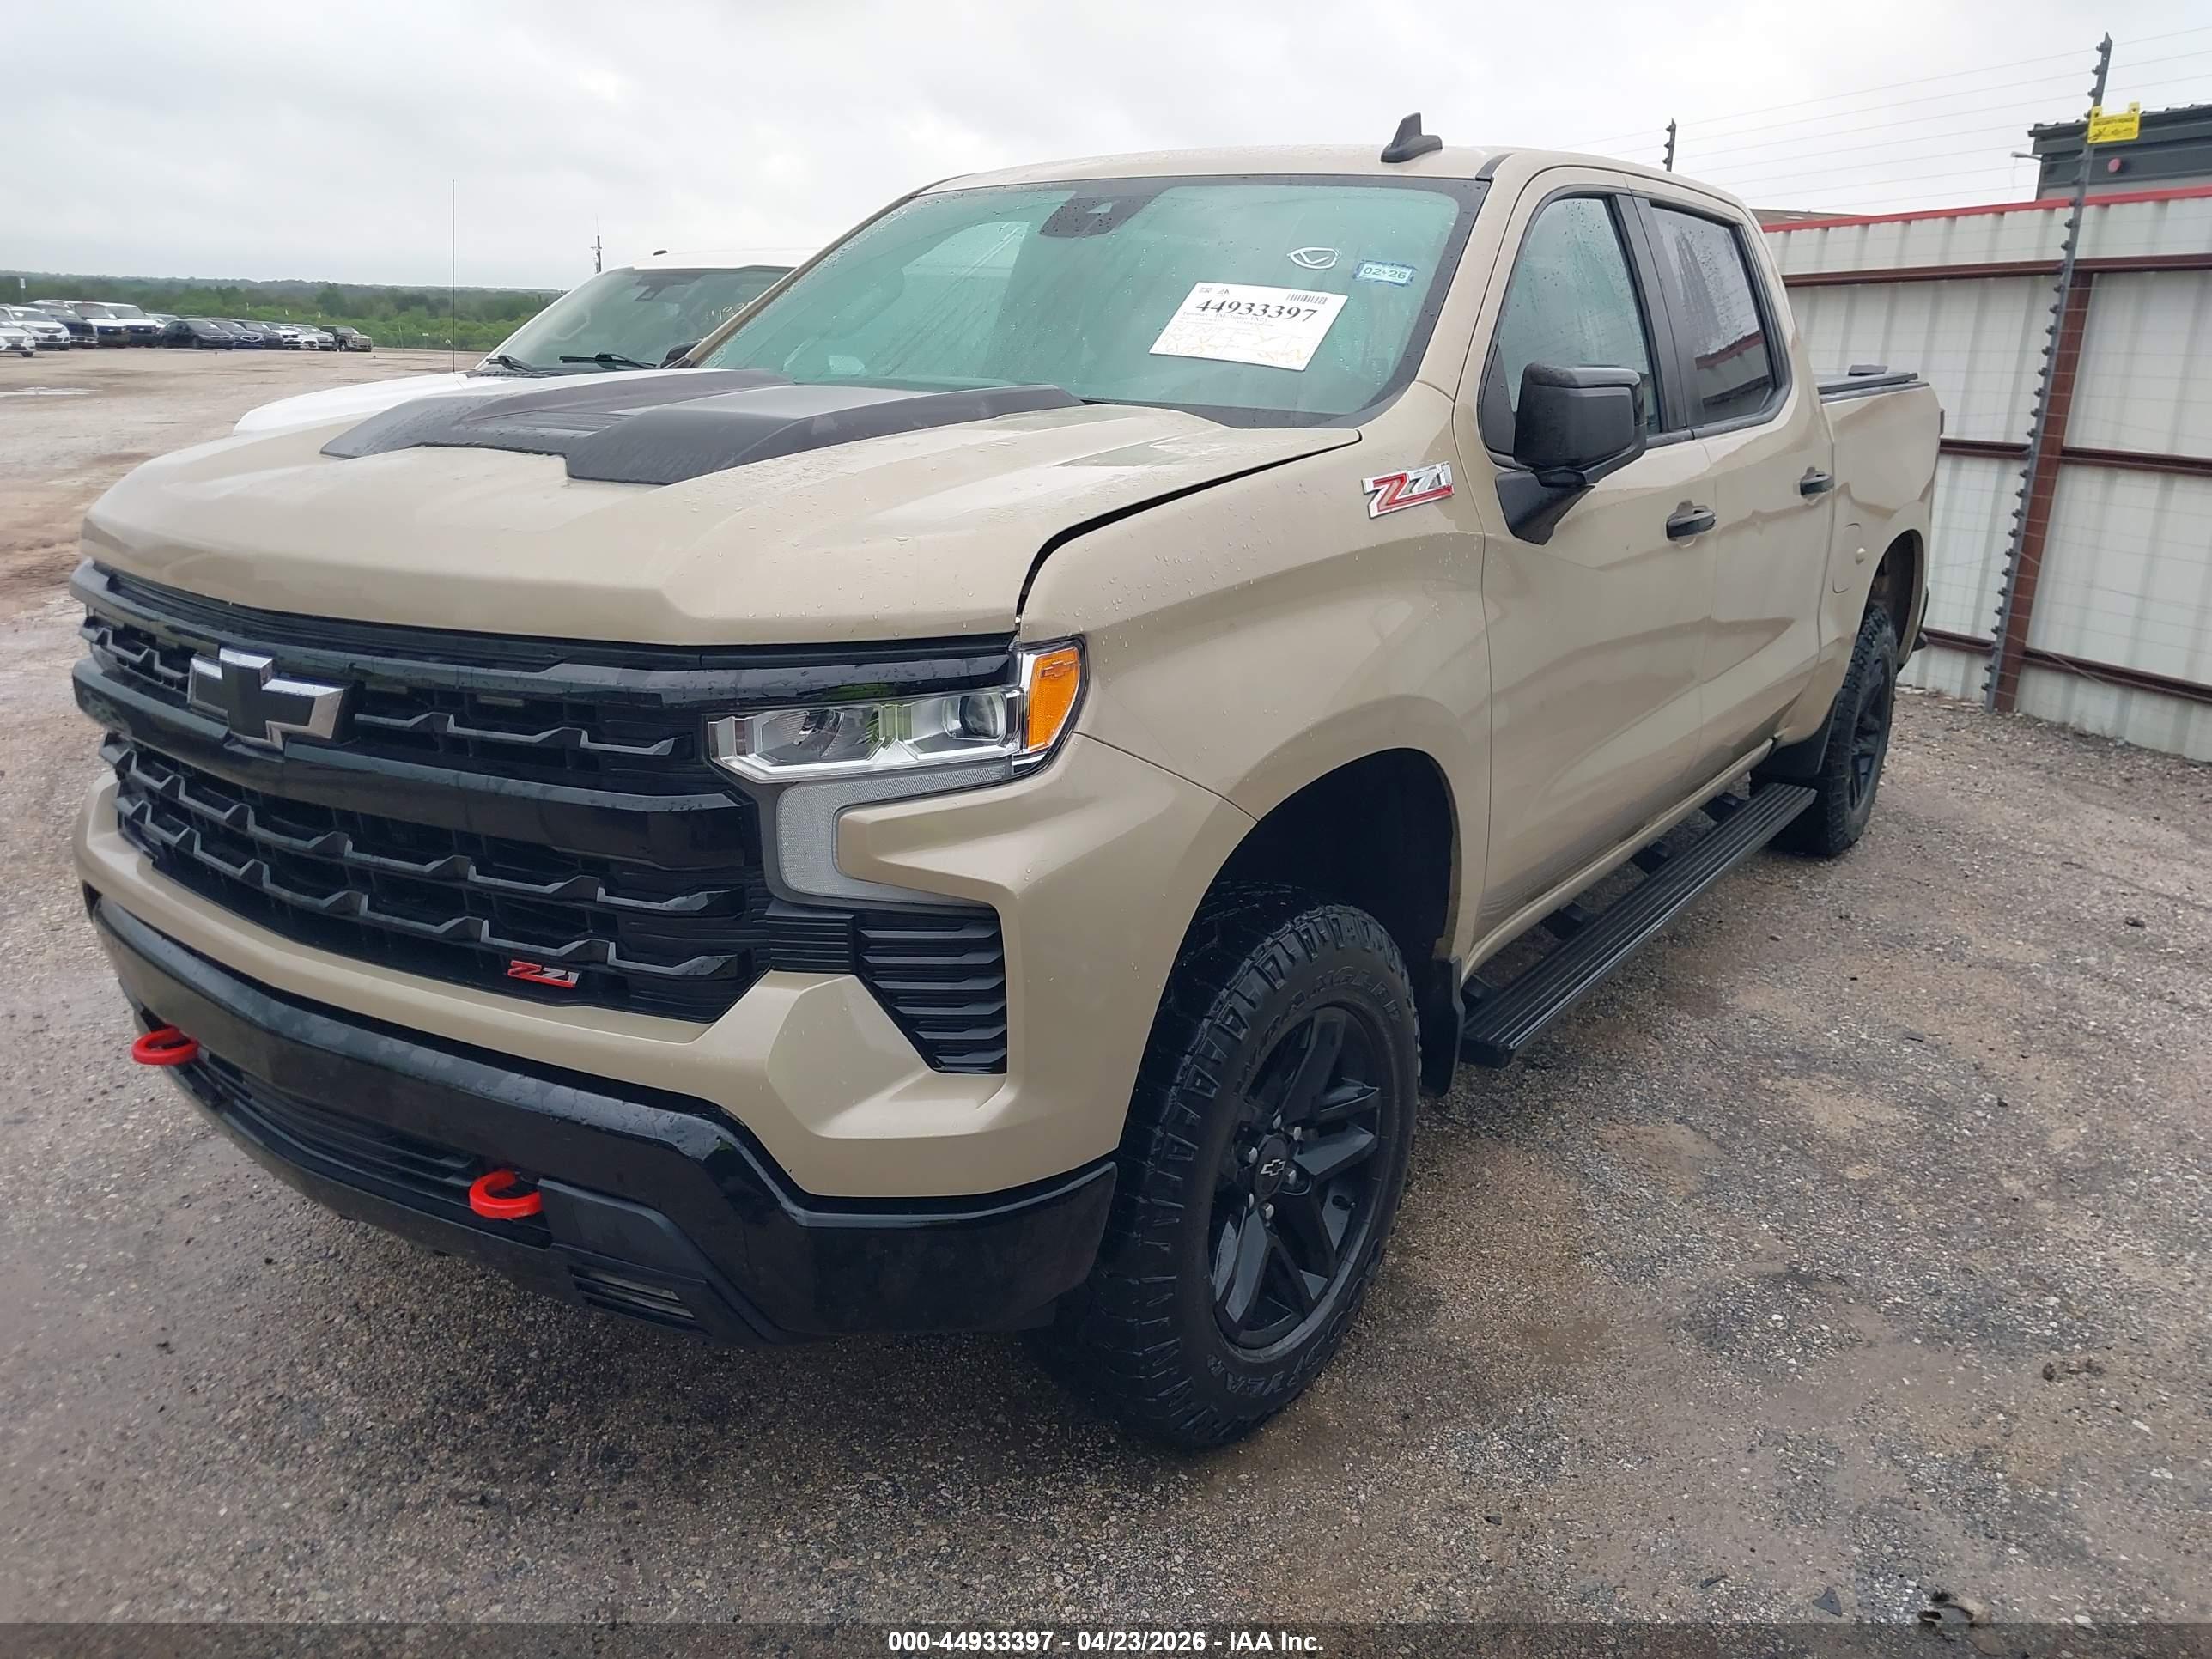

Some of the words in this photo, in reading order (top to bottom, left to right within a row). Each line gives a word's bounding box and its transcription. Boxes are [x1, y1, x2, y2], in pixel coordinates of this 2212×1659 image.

[1195, 299, 1318, 322] 44933397
[1361, 460, 1455, 518] Z71
[507, 959, 580, 988] Z71
